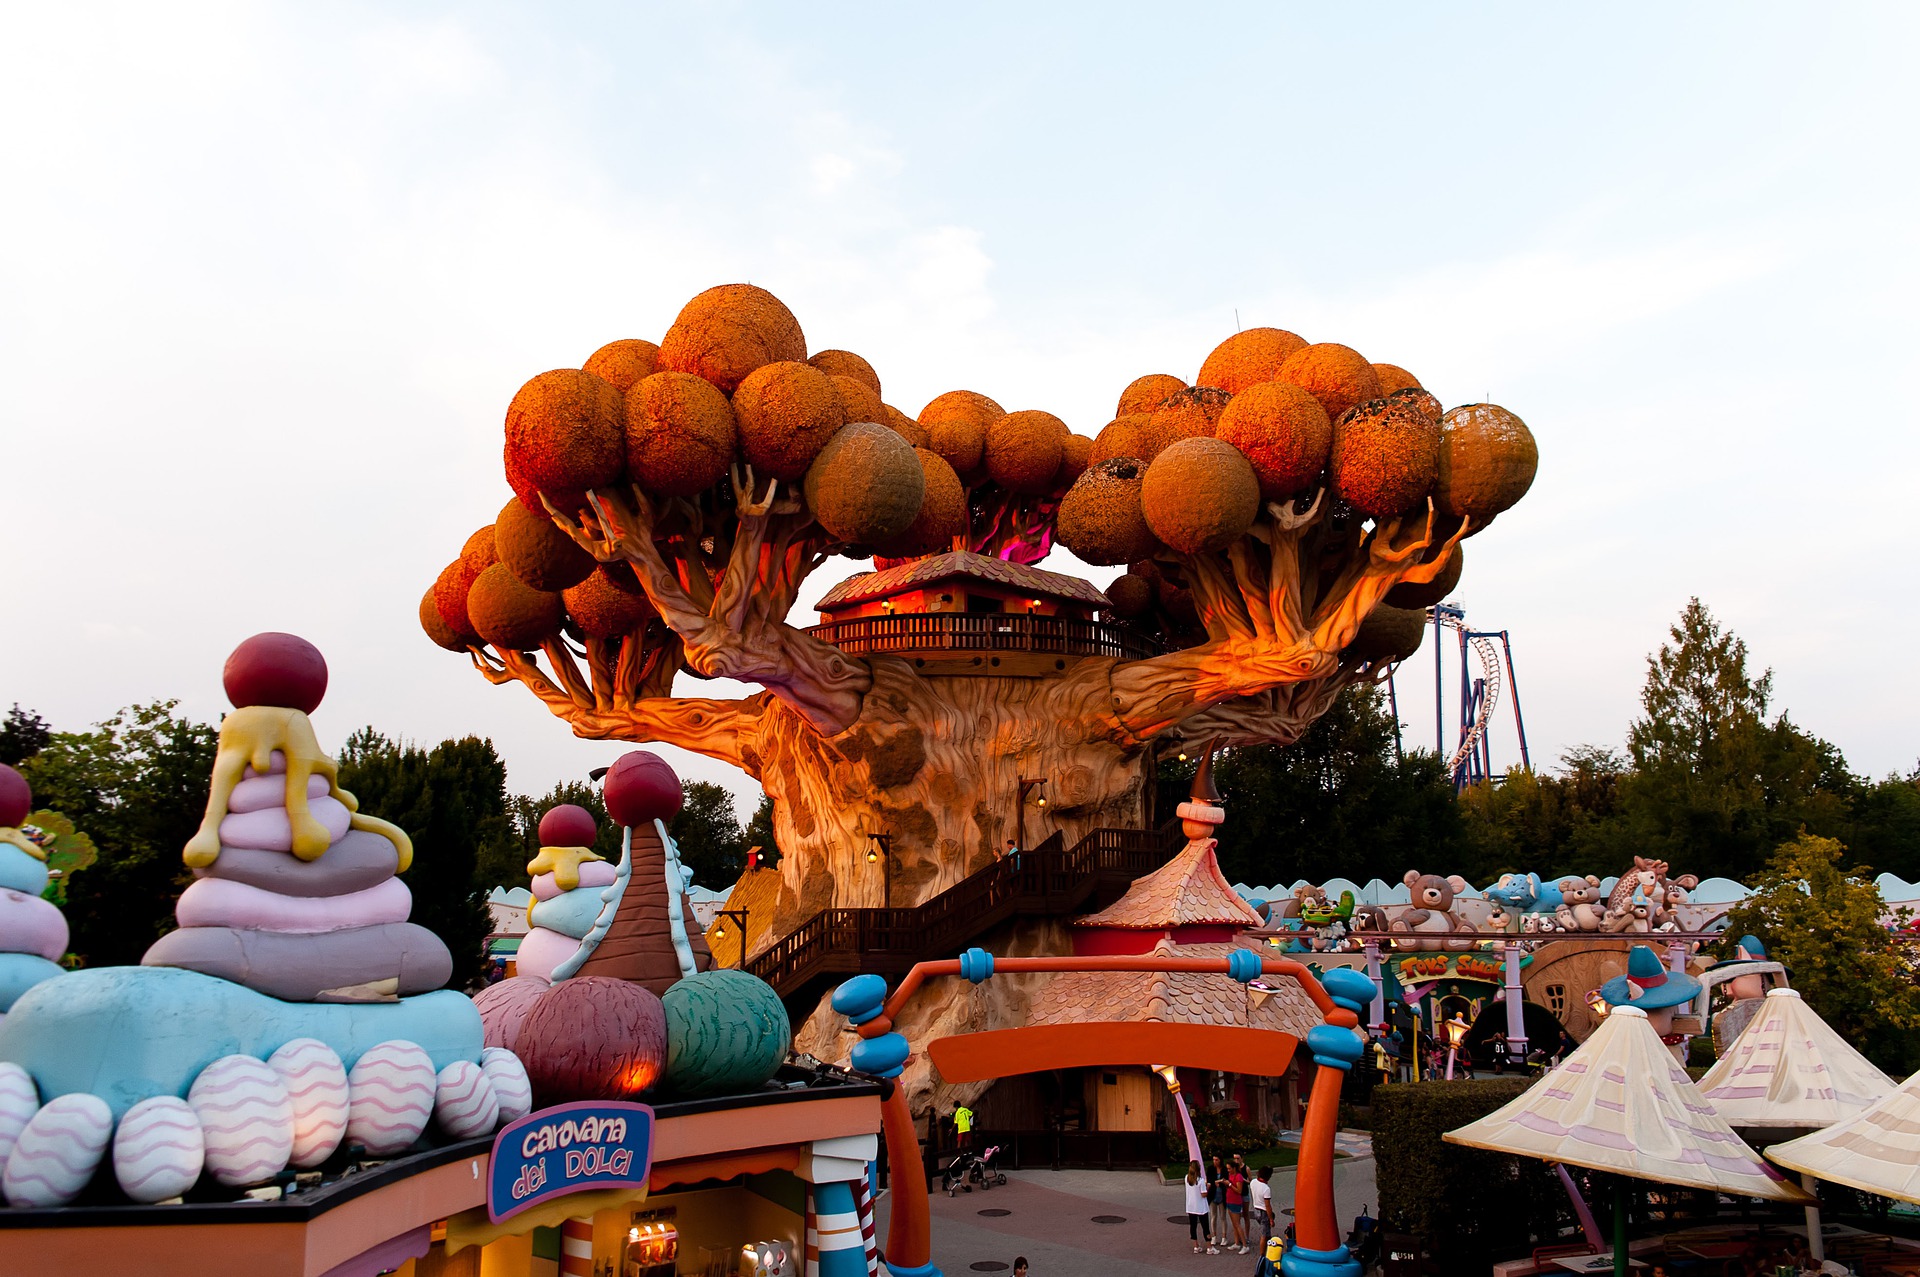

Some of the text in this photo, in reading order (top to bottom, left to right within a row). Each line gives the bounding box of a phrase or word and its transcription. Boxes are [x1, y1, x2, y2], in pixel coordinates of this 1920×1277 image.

[1400, 955, 1448, 979] TOYS
[512, 1146, 633, 1199] dei DOLCI
